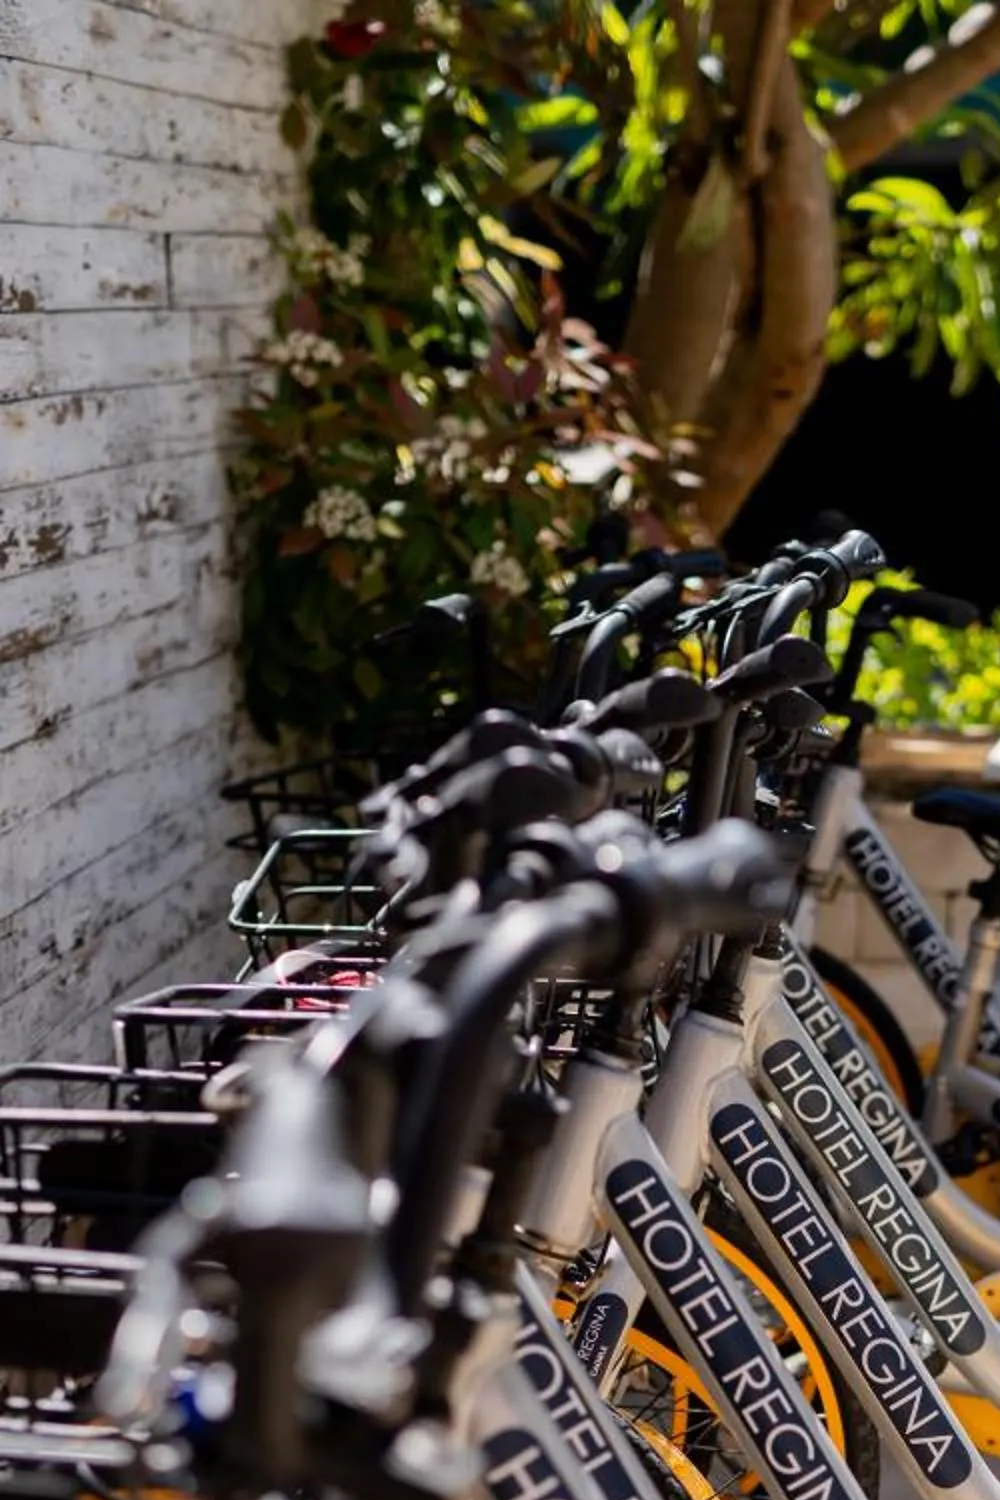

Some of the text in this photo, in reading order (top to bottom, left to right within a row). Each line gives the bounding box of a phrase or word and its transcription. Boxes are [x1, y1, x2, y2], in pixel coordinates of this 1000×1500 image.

[852, 837, 923, 933] HOTEL
[782, 950, 928, 1188] OTEL REGINA
[613, 1176, 738, 1357] HOTEL
[769, 1052, 972, 1345] HOTEL REGINA
[577, 1305, 610, 1361] REGINA
[716, 1120, 953, 1476] HOTEL REGINA
[515, 1324, 613, 1474] OTEL
